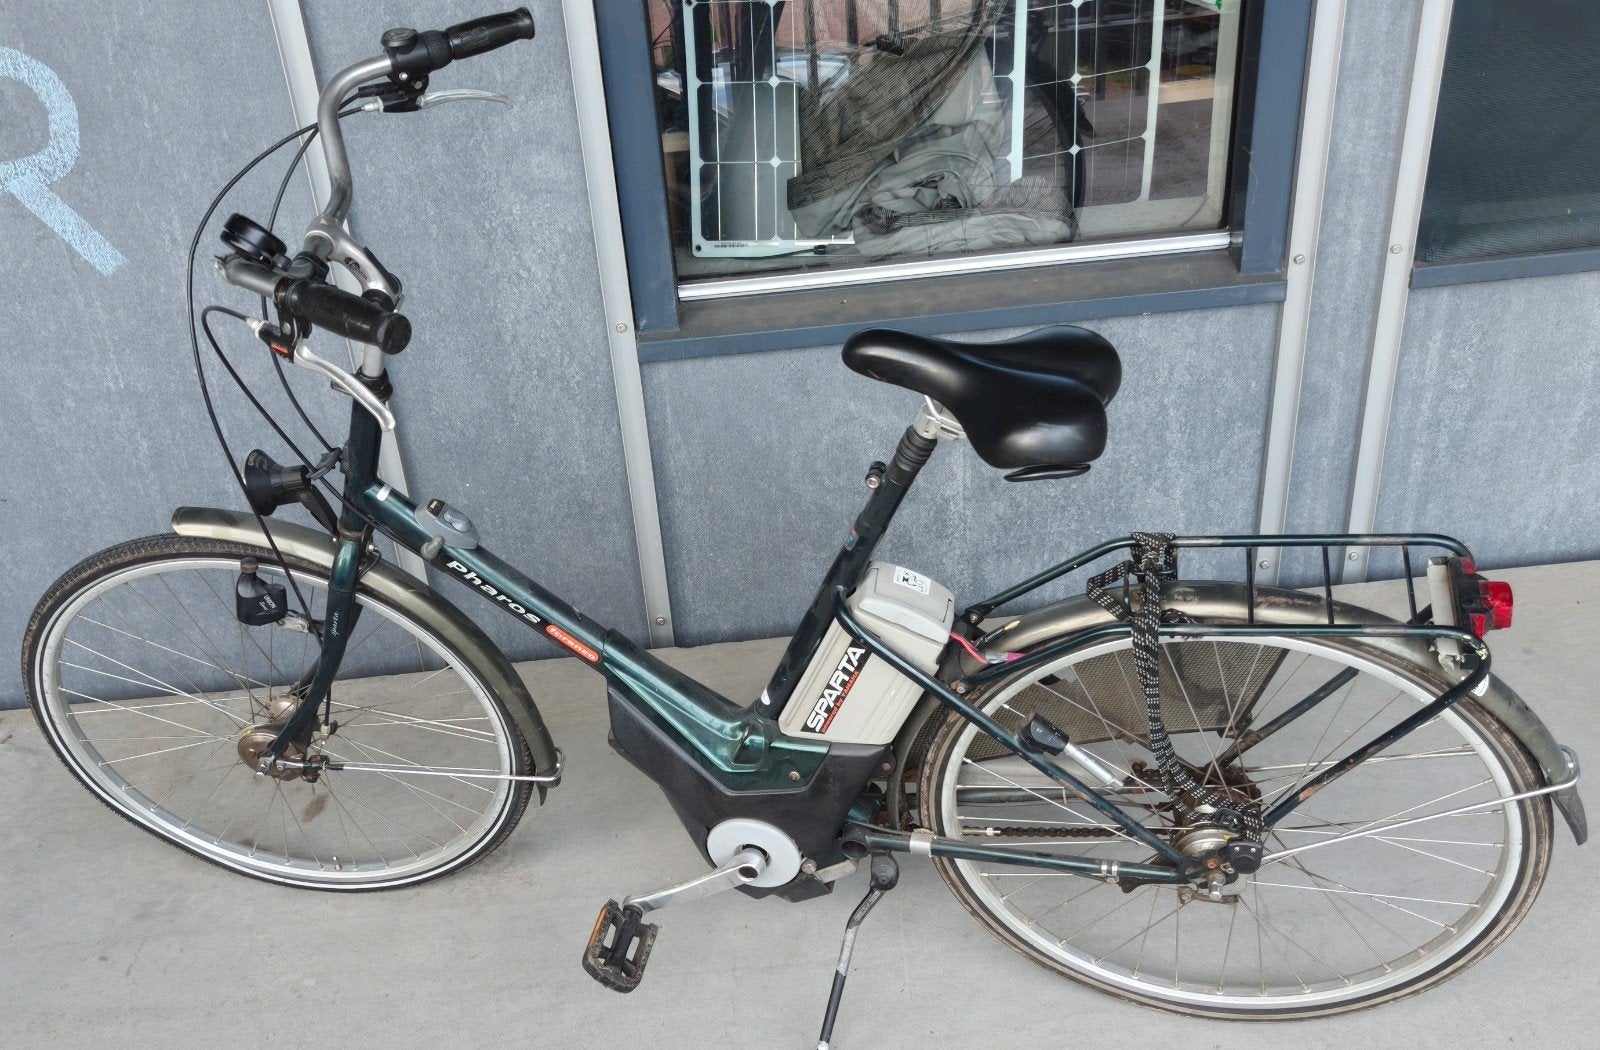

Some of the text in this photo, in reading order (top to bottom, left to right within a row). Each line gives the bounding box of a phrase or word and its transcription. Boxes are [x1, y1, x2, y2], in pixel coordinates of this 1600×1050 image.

[0, 46, 129, 278] R
[446, 560, 541, 624] Pharos
[806, 646, 866, 733] SPARTA
[821, 706, 838, 734] powered
[841, 670, 860, 697] YAMAHA
